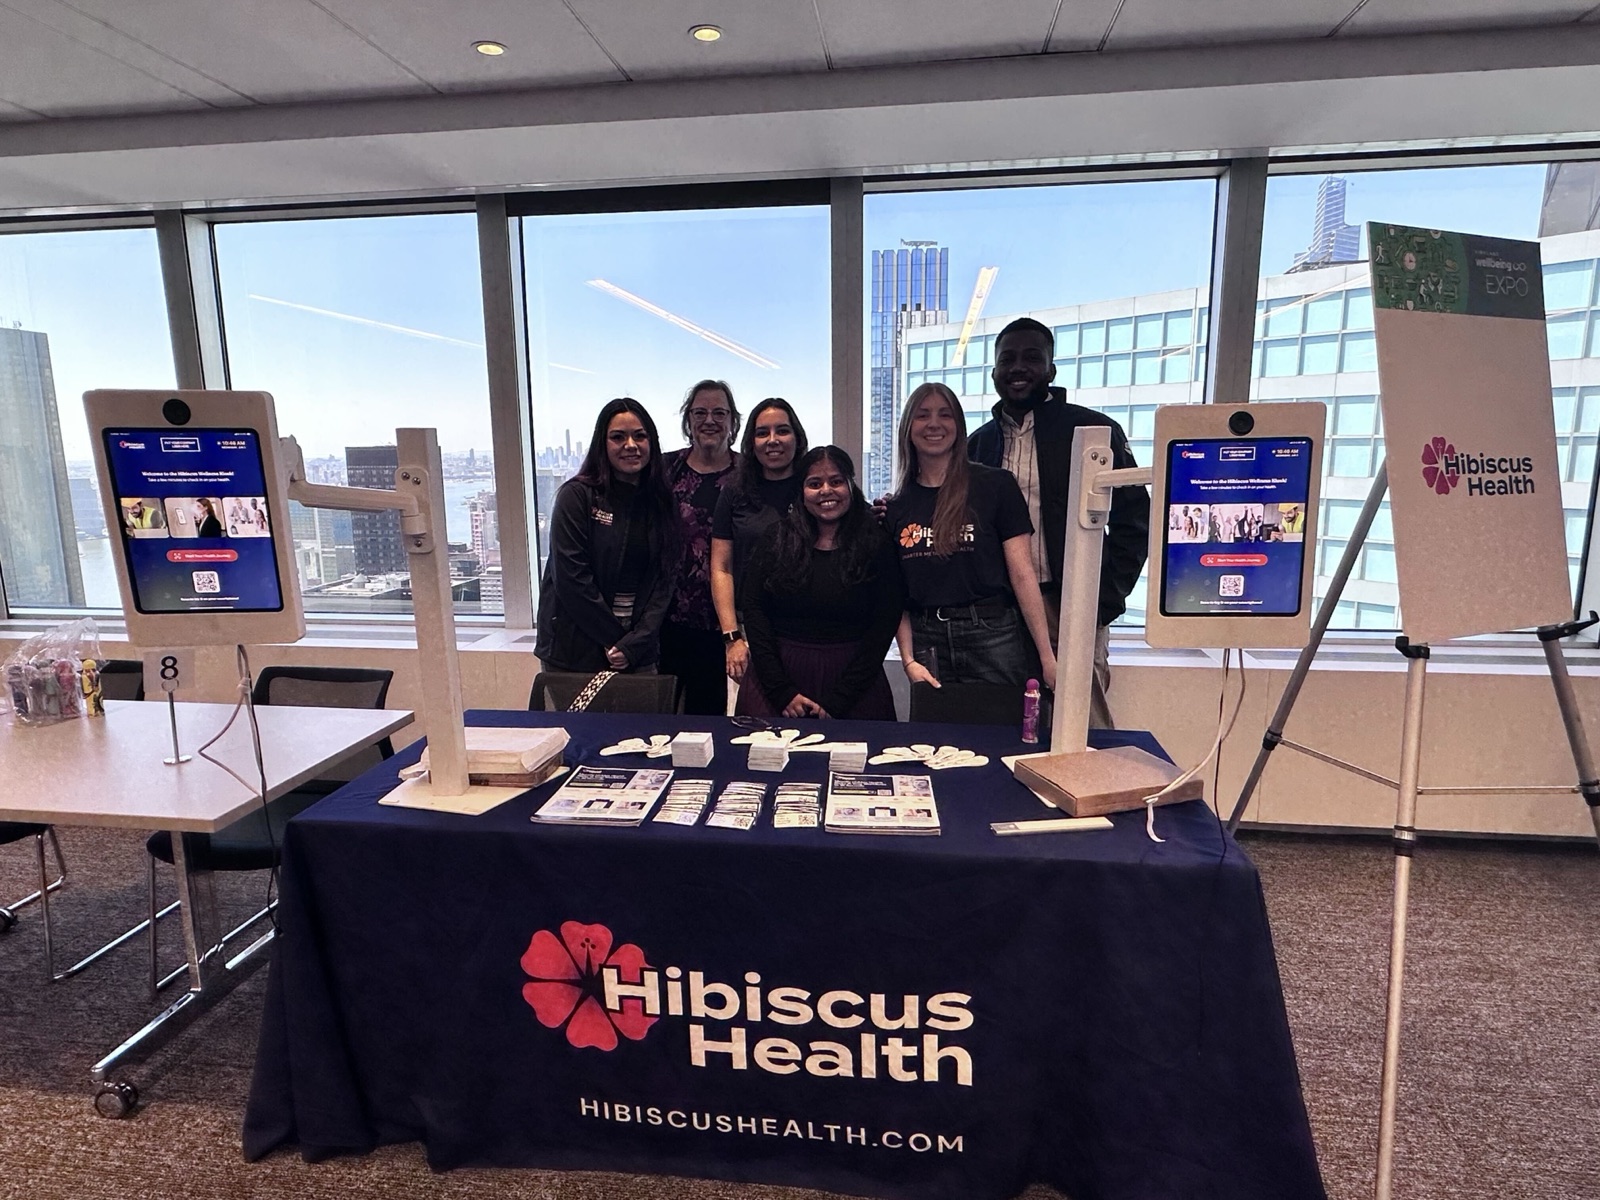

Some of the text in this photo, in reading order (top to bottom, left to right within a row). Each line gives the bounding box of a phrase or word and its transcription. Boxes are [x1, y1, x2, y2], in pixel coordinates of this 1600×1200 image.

[1486, 274, 1528, 296] EXPO
[1444, 452, 1533, 475] Hibiscus
[1468, 475, 1535, 496] Health
[912, 524, 974, 538] Hibs
[160, 656, 178, 680] 8
[602, 966, 975, 1031] Hibiscus
[689, 1024, 973, 1086] Health
[580, 1097, 964, 1153] HIBISCUSHEALTH.COM
